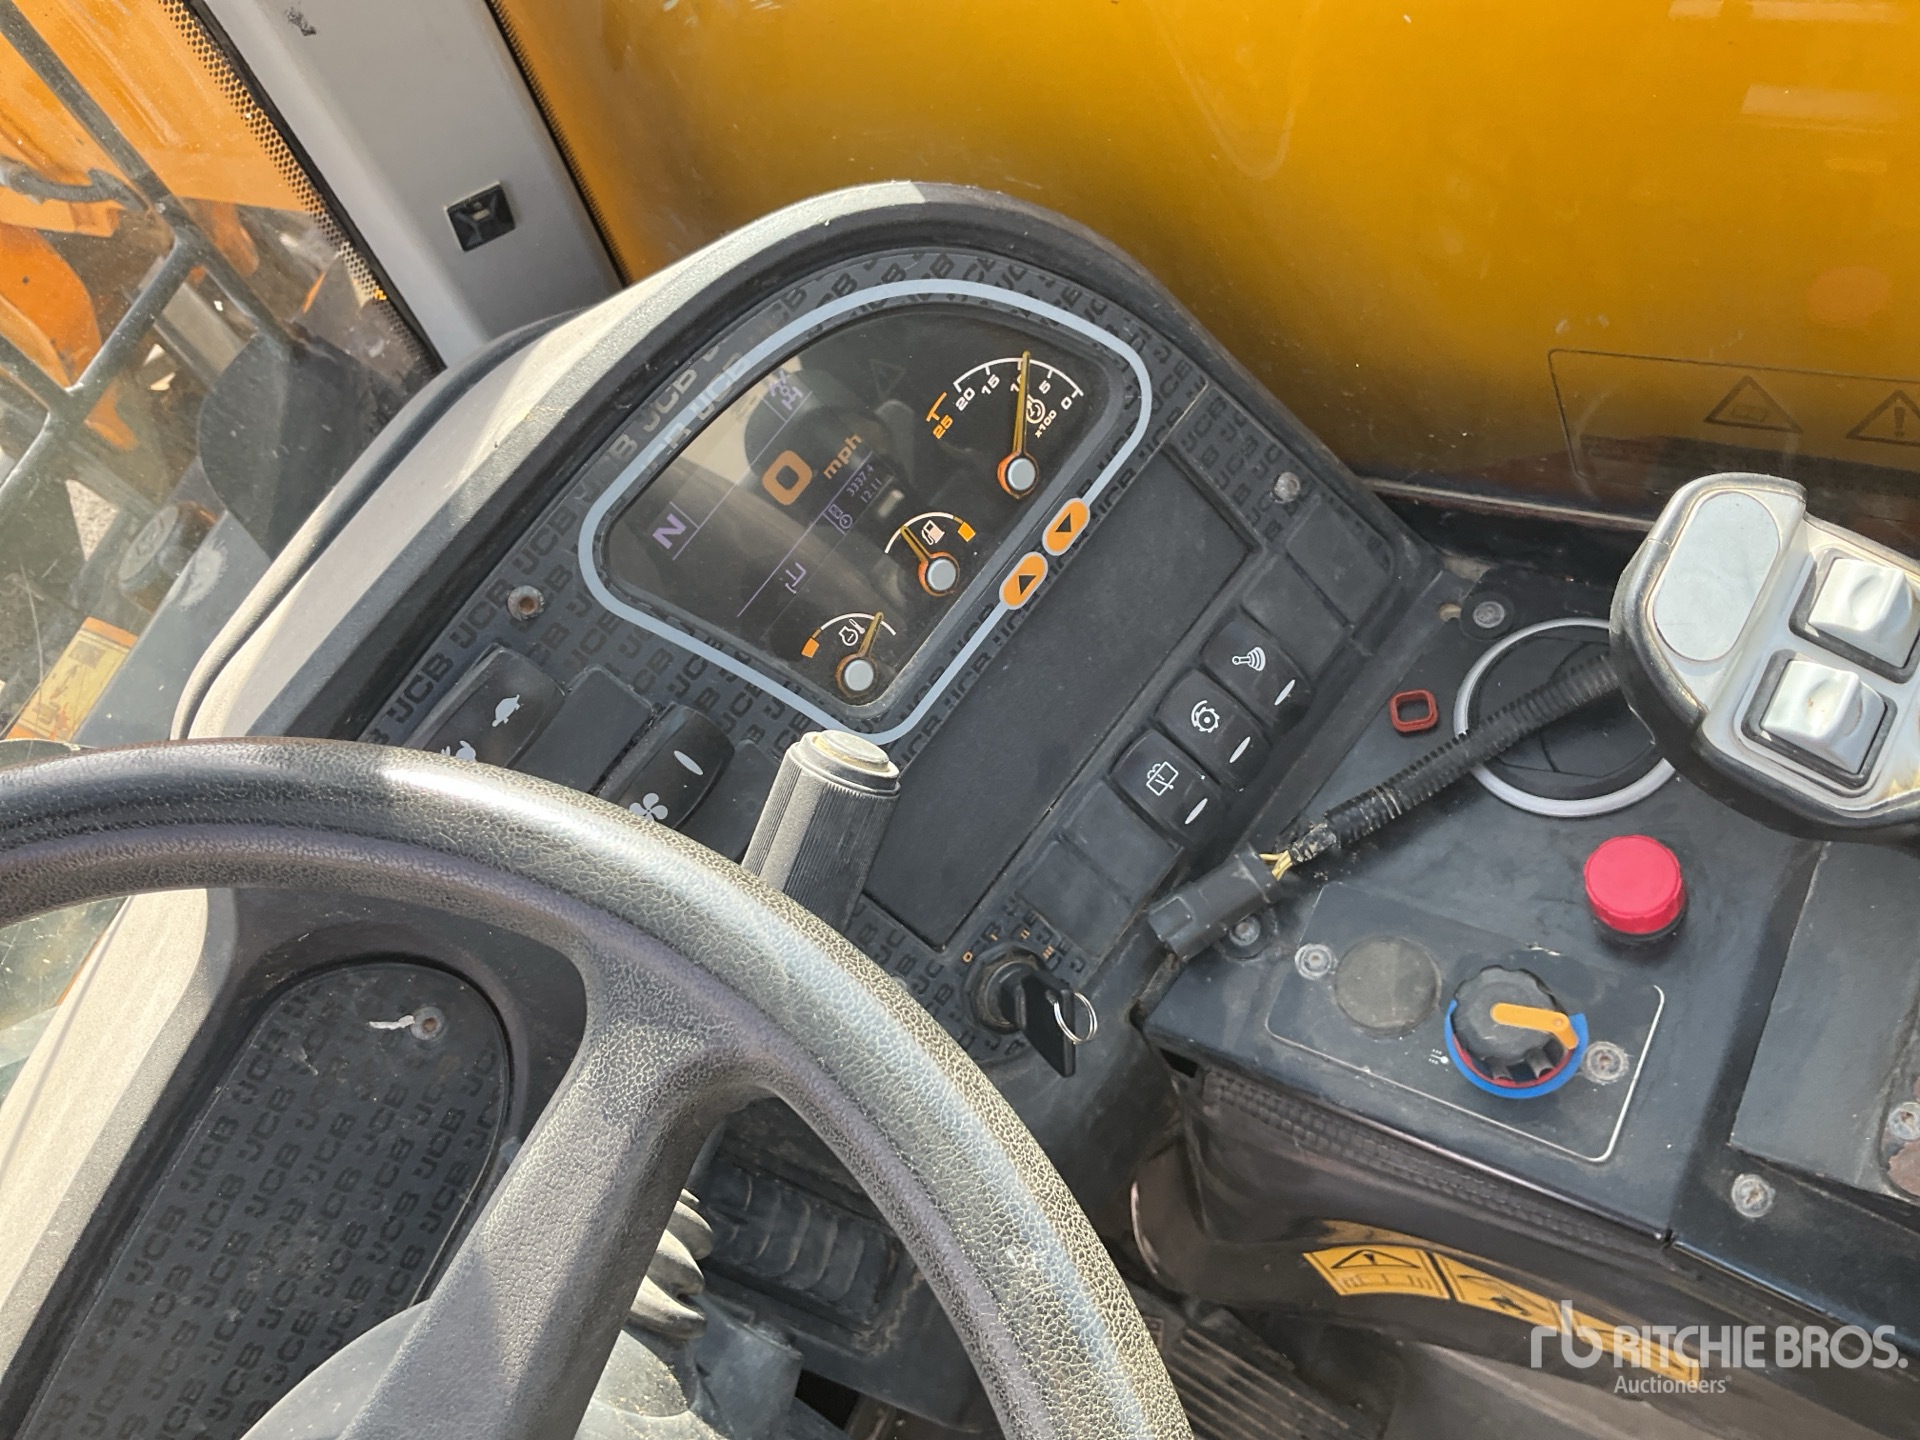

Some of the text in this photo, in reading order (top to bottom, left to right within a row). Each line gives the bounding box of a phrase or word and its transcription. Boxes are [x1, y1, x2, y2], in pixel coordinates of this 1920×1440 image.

[955, 387, 976, 411] 20
[981, 374, 1000, 395] 15
[1038, 380, 1051, 395] 5
[1061, 397, 1073, 411] 0
[932, 414, 954, 439] 25
[1034, 409, 1057, 439] x100
[762, 432, 864, 505] 0 mph
[512, 506, 577, 574] JCB
[652, 513, 687, 549] N
[388, 653, 454, 723] JCB
[631, 647, 674, 696] CB
[180, 1115, 240, 1193] JCB
[236, 1086, 296, 1162] JCB
[300, 1112, 356, 1184] JCB
[412, 1107, 467, 1179] JCB
[244, 1141, 301, 1218] JCB
[305, 1167, 362, 1242] JCB
[359, 1137, 415, 1211] JCB
[420, 1160, 471, 1234] JCB
[125, 1205, 187, 1286] JCB
[186, 1174, 245, 1250] JCB
[366, 1190, 420, 1264] JCB
[132, 1264, 193, 1340] JCB
[206, 1341, 265, 1422] JCB
[263, 1309, 319, 1385] JCB
